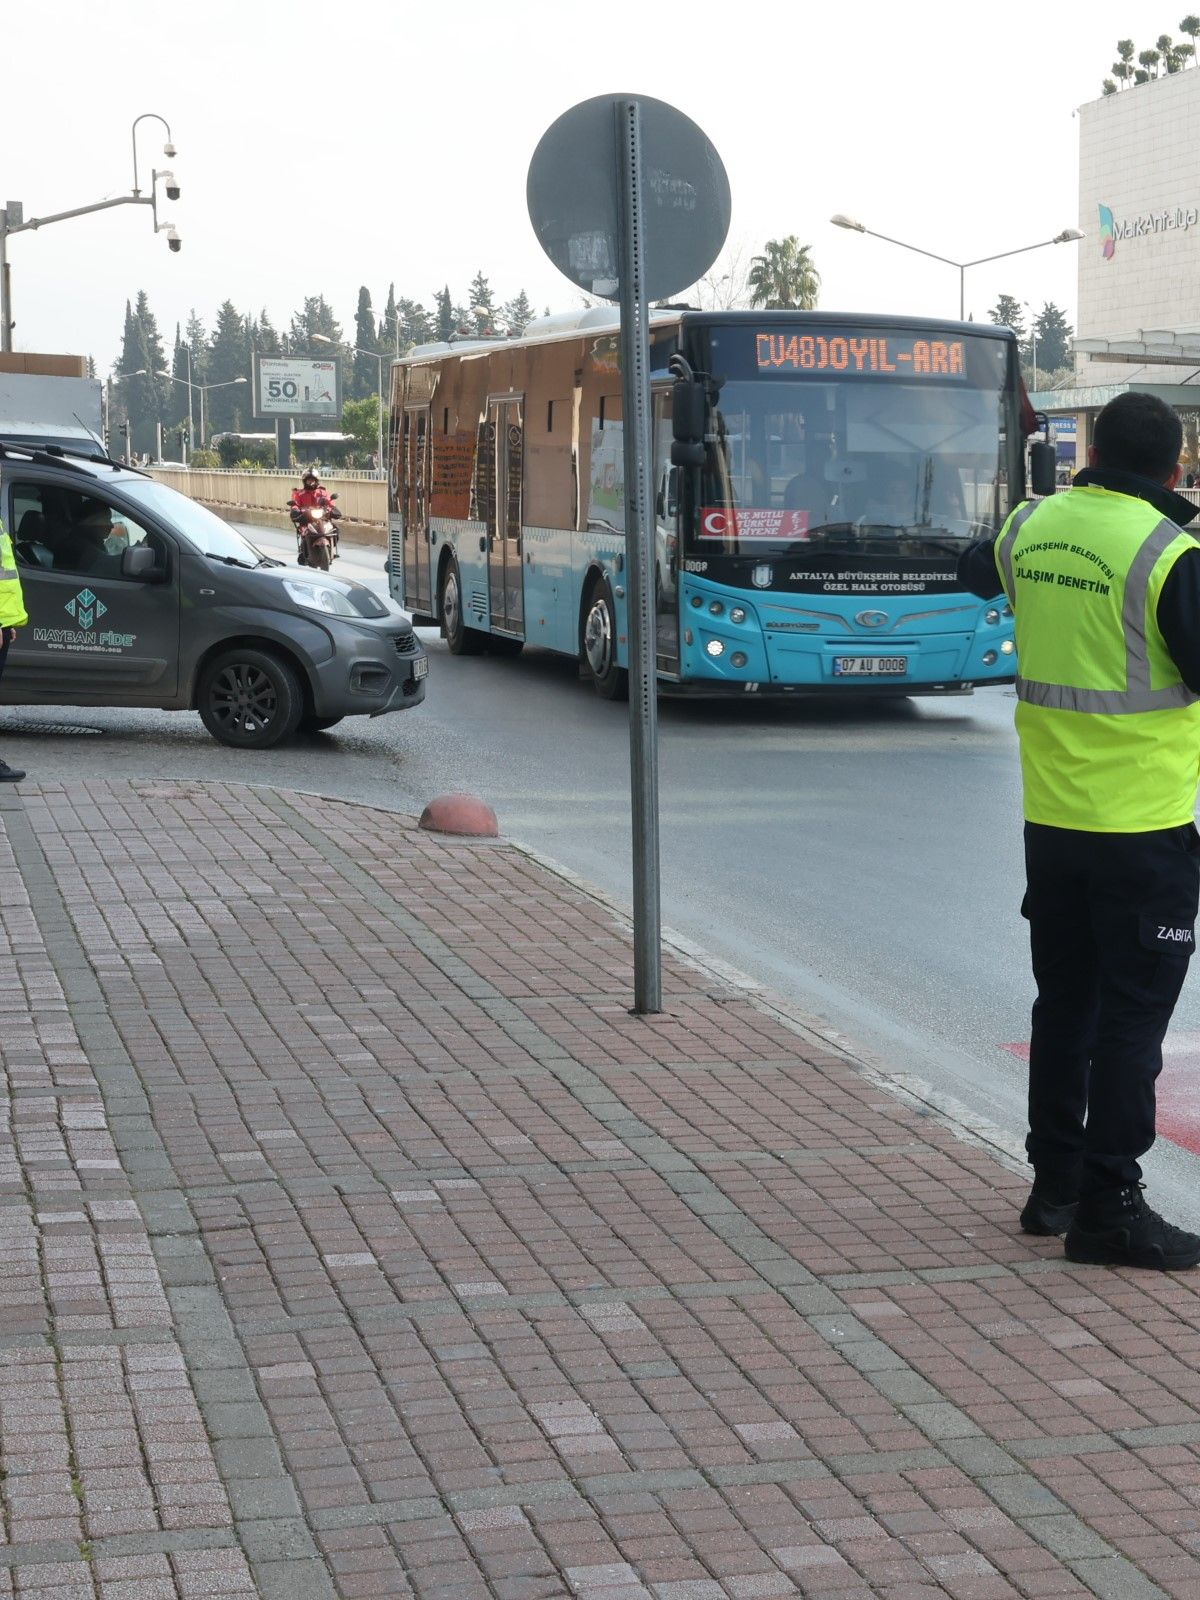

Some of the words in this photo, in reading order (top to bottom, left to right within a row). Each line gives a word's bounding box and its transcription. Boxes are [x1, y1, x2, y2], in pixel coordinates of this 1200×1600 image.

[1112, 208, 1198, 241] MarkAntalya
[752, 510, 785, 519] MUTLU
[1070, 544, 1115, 580] BELEDİYESİ
[789, 572, 835, 581] ANTALYA
[837, 571, 900, 582] BÜYÜKŞEHİR
[902, 571, 958, 581] BELEDİYESİ
[823, 583, 850, 592] ÖZEL
[851, 583, 878, 592] HALK
[880, 583, 926, 592] OTOBÜSÜ
[1057, 574, 1110, 596] DENETİM
[33, 628, 97, 644] MAYBAN
[842, 659, 855, 671] 07
[860, 659, 873, 671] AU
[878, 659, 905, 671] 0008
[1157, 926, 1193, 942] ZABITA
